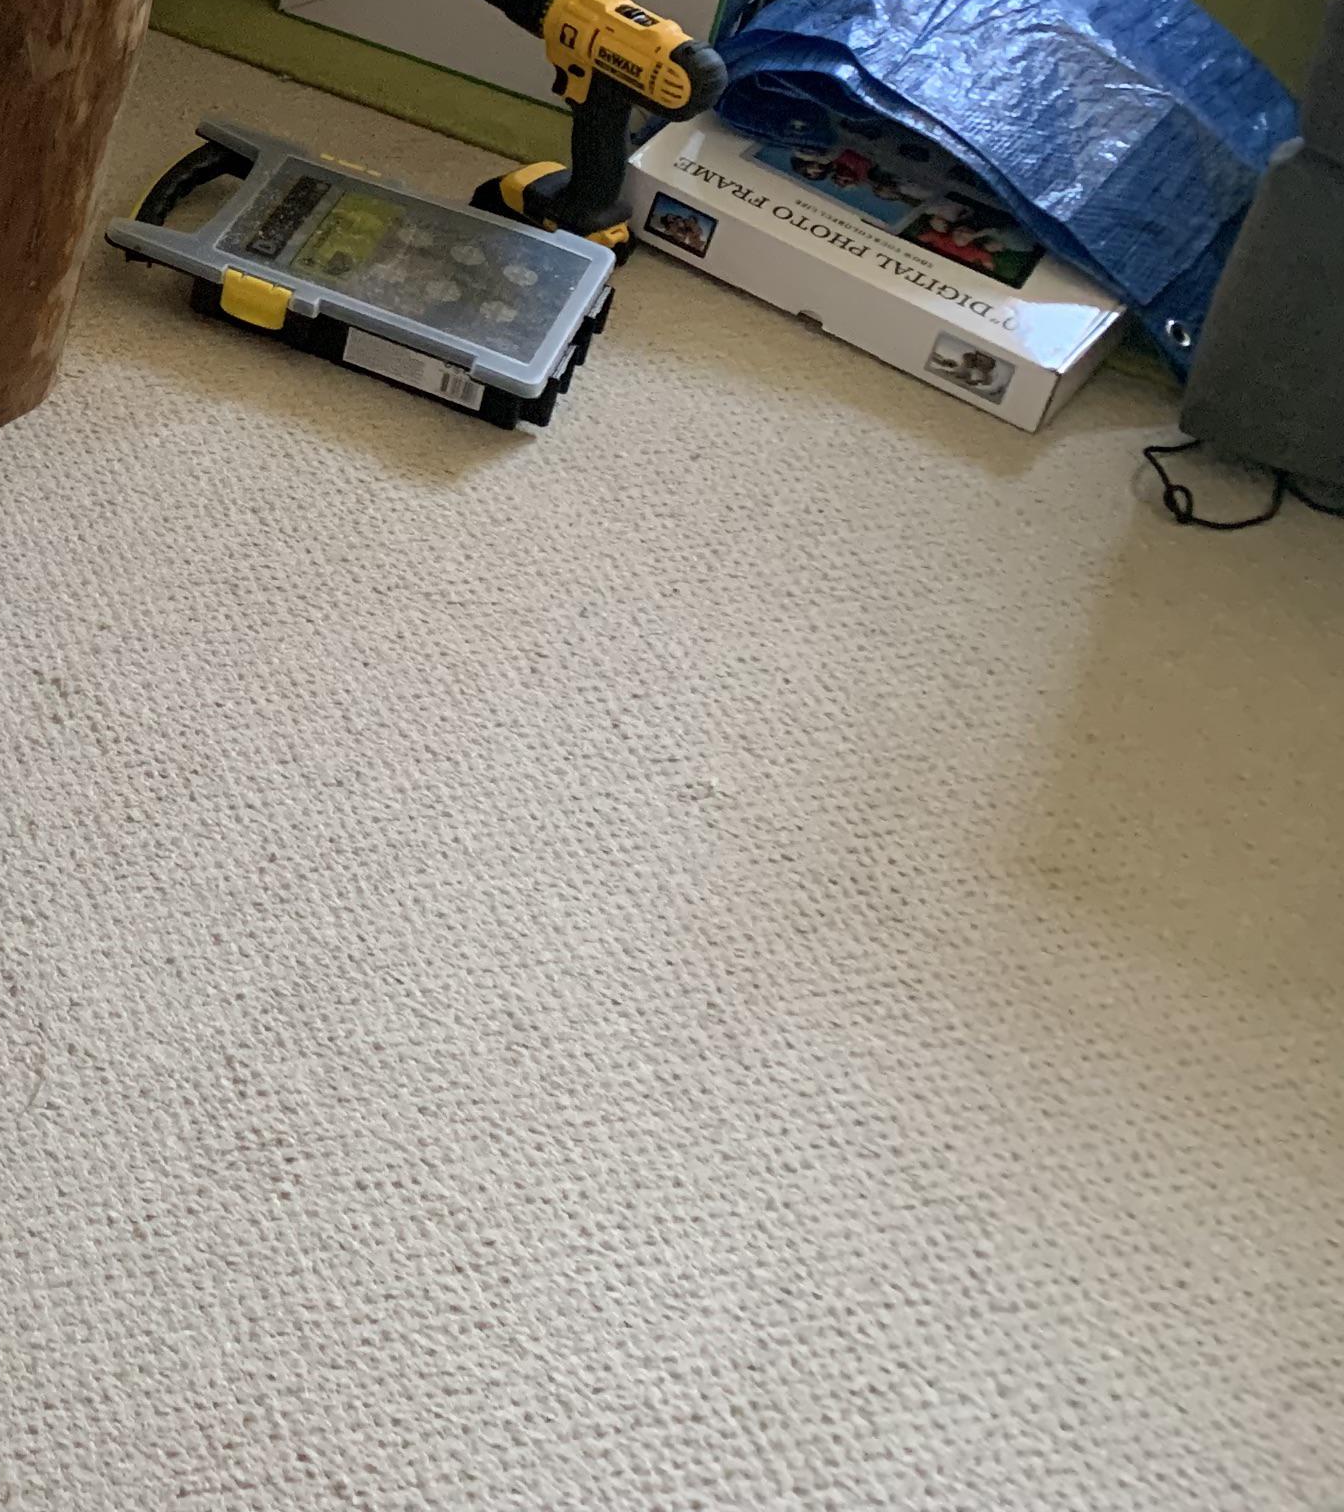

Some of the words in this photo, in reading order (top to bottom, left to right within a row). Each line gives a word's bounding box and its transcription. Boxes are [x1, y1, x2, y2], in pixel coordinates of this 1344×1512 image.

[673, 156, 770, 209] FRAME
[772, 205, 872, 258] PHOTO
[876, 253, 994, 317] DIGITAL
